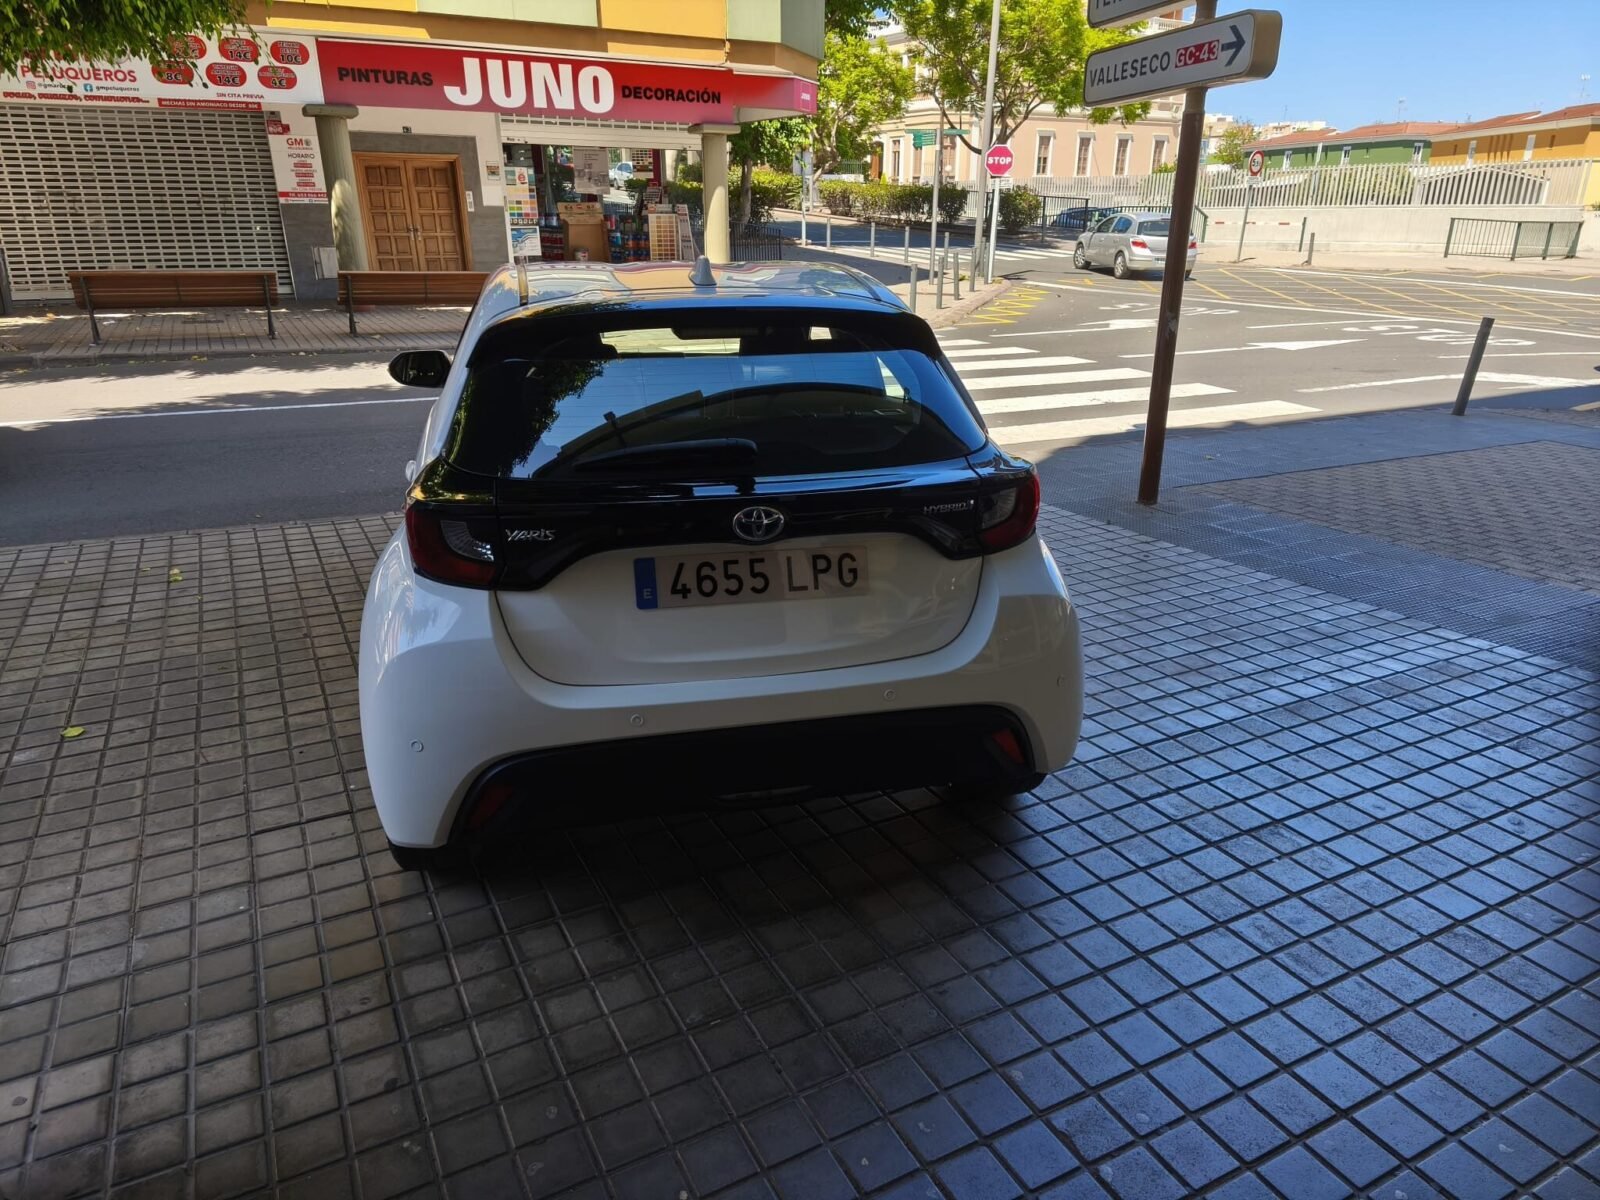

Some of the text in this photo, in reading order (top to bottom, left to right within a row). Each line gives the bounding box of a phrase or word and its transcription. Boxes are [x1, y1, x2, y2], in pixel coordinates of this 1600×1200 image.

[280, 54, 301, 64] 10€
[1090, 40, 1219, 87] VALLESECO GC-43
[20, 65, 137, 82] PEUQUEROS
[217, 75, 240, 85] 14€
[337, 67, 433, 86] PINTURAS
[443, 57, 614, 114] JUNO
[622, 85, 721, 104] DECORACIÓN
[286, 137, 304, 146] GM
[987, 156, 1012, 165] STOP
[923, 502, 968, 514] HYBRID
[505, 528, 557, 541] YARIS
[643, 553, 858, 599] E 4655 LPG
